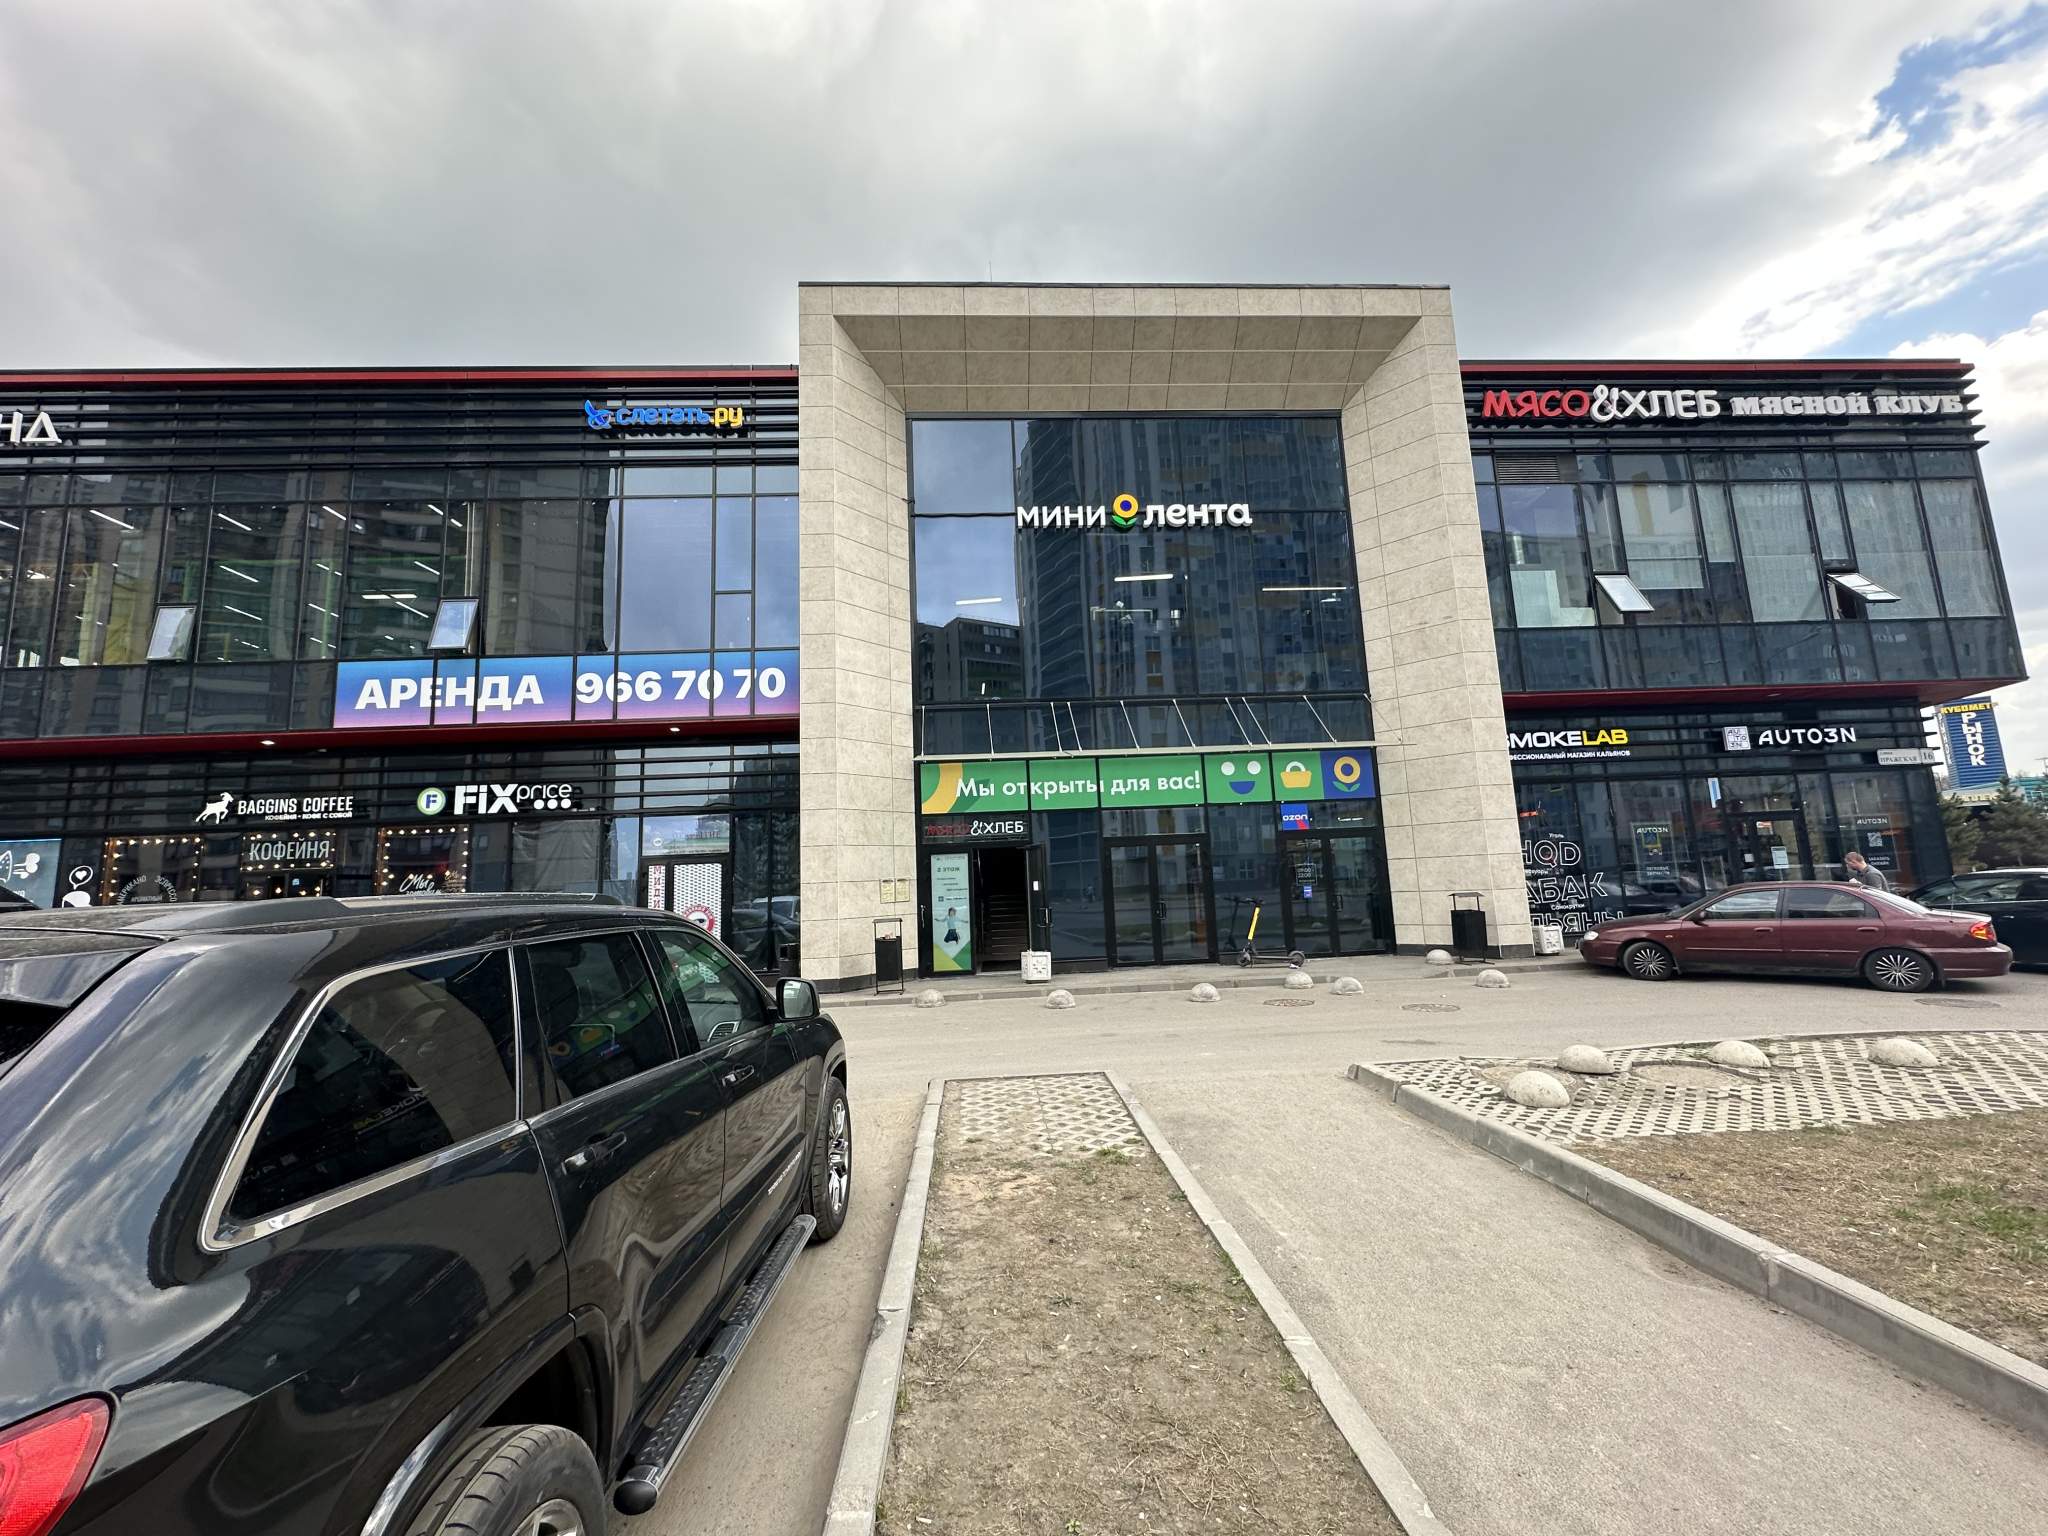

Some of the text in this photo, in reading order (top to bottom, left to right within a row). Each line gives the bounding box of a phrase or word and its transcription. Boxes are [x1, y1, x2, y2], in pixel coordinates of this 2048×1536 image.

[1482, 384, 1964, 422] МЯСО&ХЛЕБ МЯСНОЙ КЛУБ
[616, 406, 743, 428] слетать.ру
[1143, 502, 1254, 527] лента
[355, 667, 787, 711] АРЕНДА 966 70 70
[1941, 702, 1999, 715] КУБОМЕТ
[1759, 727, 1857, 745] AUTO3N
[1961, 711, 1986, 767] РЫНОК
[1567, 751, 1596, 759] МАГАЗИН
[1597, 750, 1631, 758] КАЛЬЯНОВ
[1922, 751, 1934, 761] 16
[516, 783, 573, 803] price
[956, 770, 1200, 800] Мы открыты для вас!
[237, 796, 354, 815] BAGGINS COFFEE
[249, 837, 330, 862] КОФЕЙНЯ
